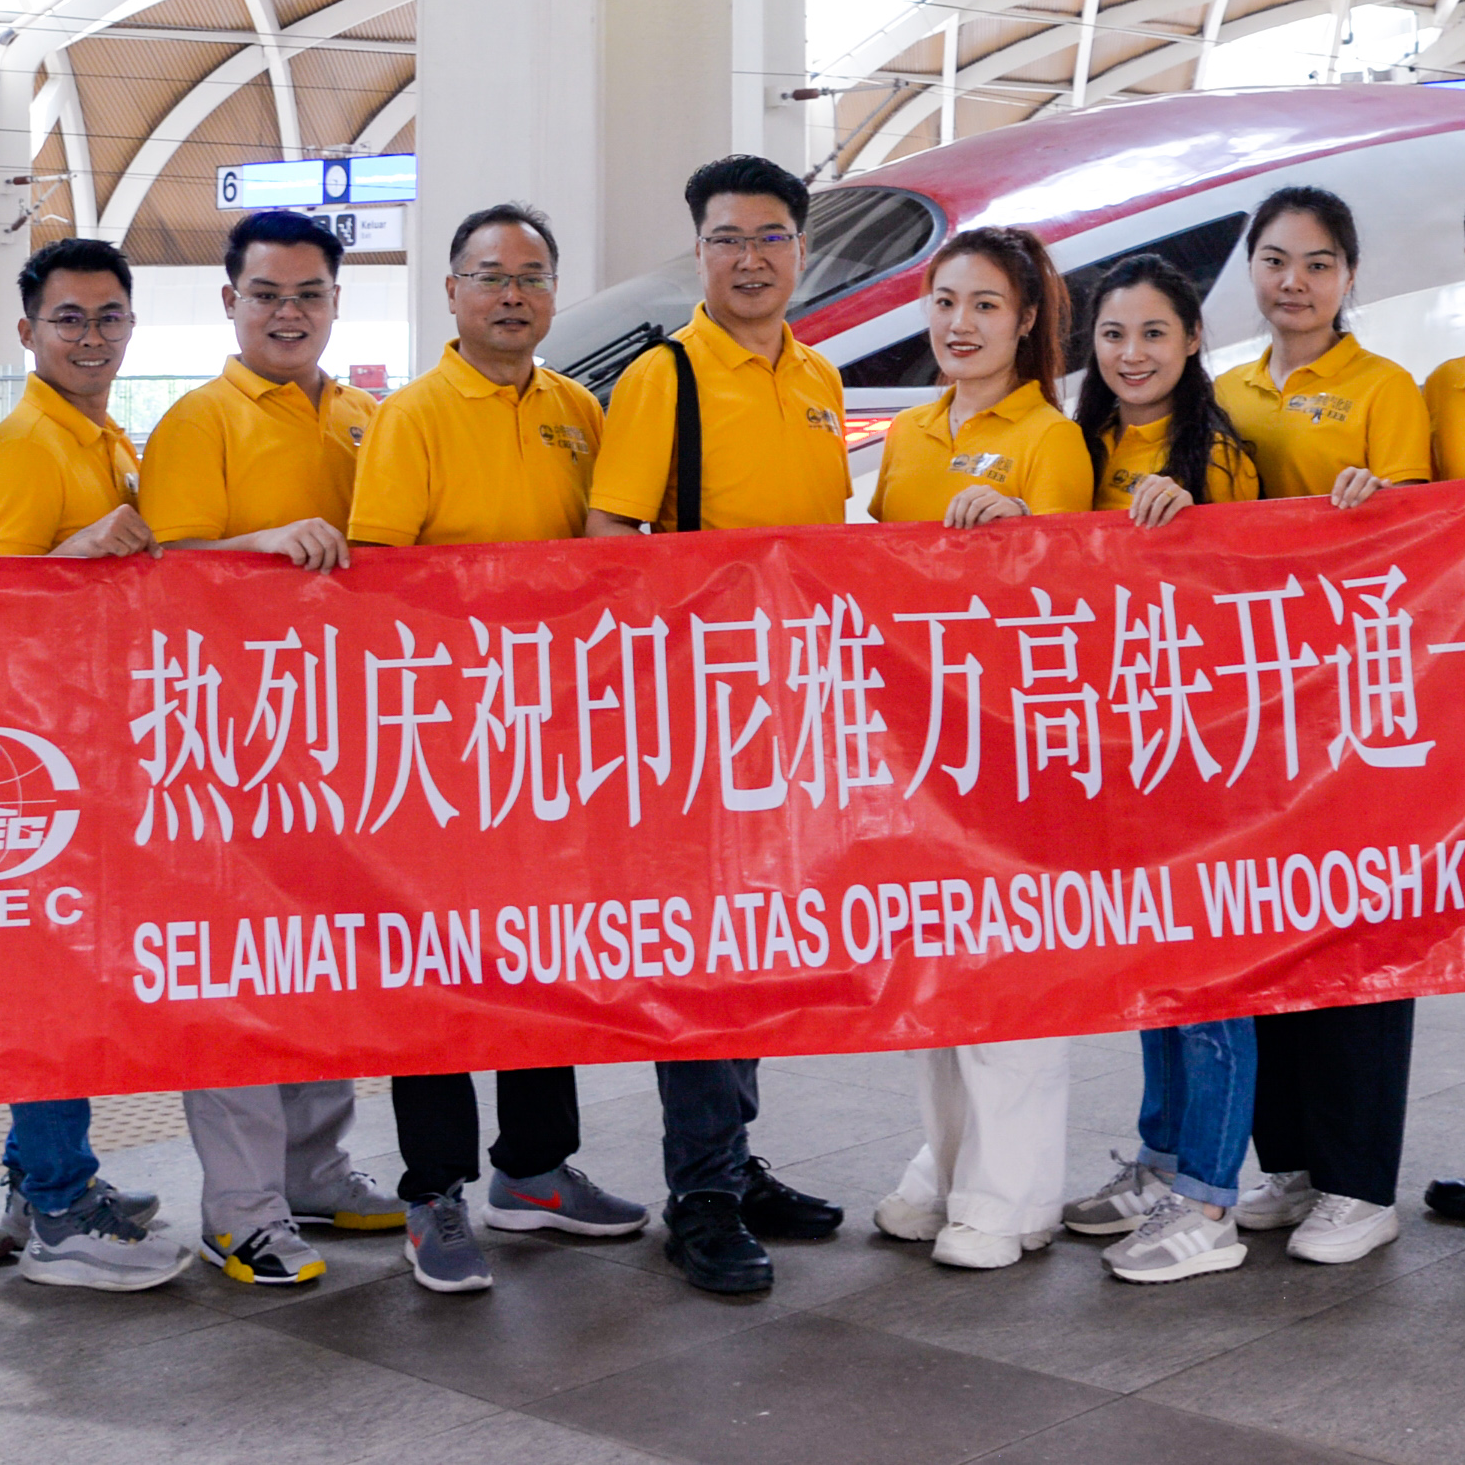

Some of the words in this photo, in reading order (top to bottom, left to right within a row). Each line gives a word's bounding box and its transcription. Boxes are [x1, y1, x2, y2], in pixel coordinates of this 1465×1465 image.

[222, 171, 238, 203] 6
[360, 220, 387, 230] Keluar
[134, 914, 365, 1003] SELAMAT
[379, 909, 483, 988] DAN
[496, 897, 695, 985] SUKSES
[706, 888, 830, 974] ATAS
[841, 866, 1194, 964] OPERASIONAL
[1197, 845, 1422, 938] WHOOSH
